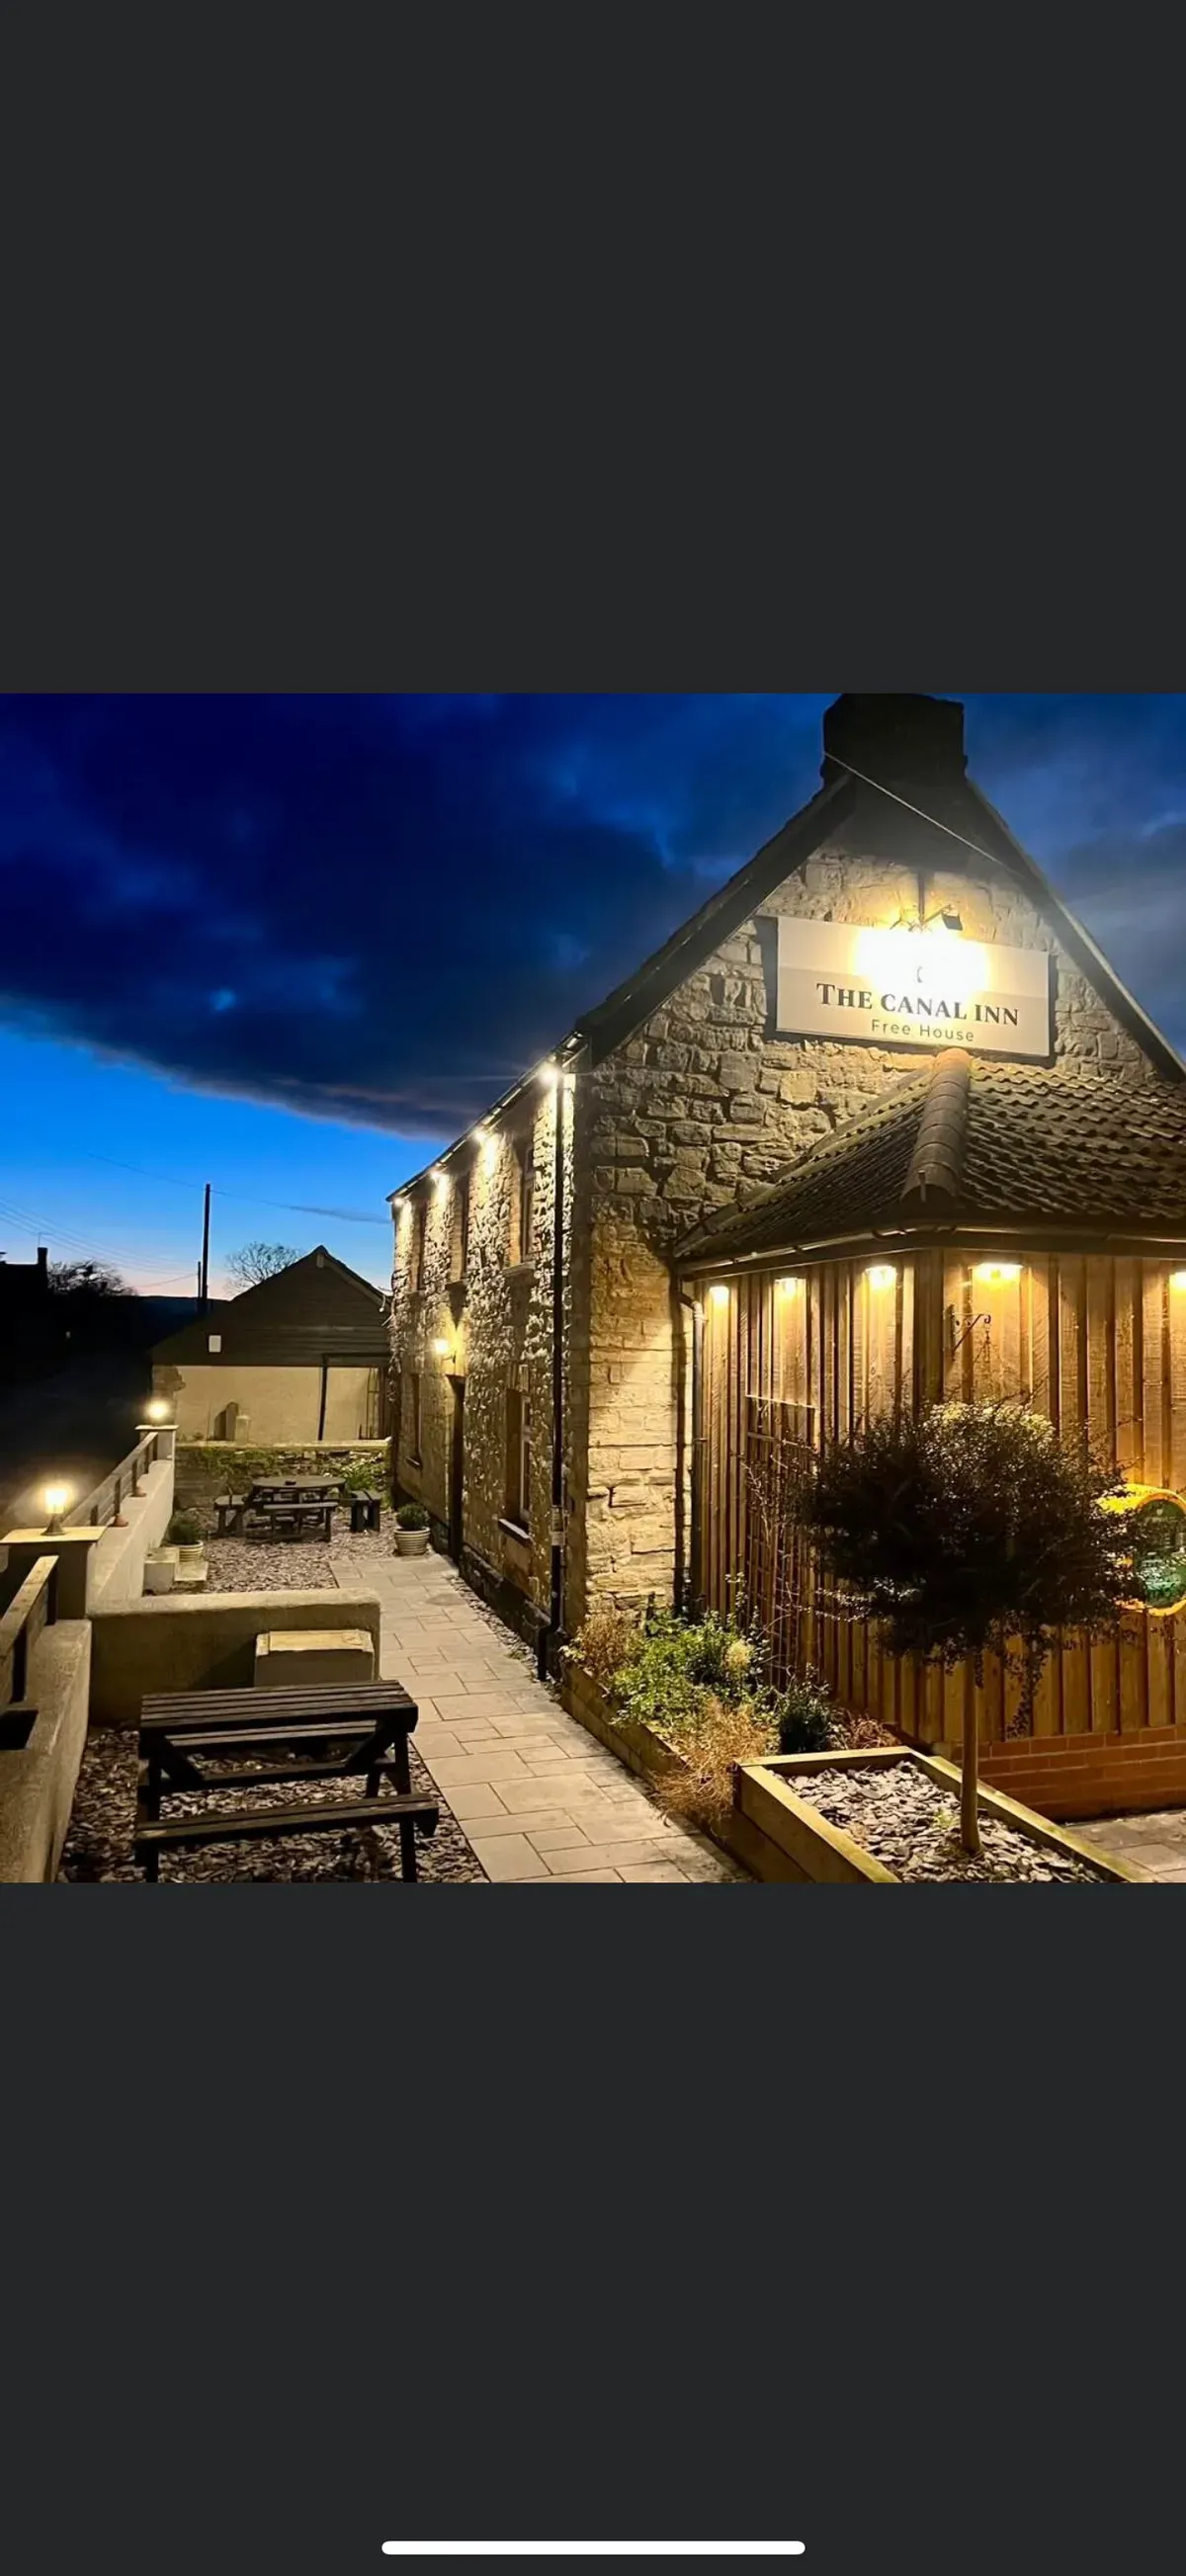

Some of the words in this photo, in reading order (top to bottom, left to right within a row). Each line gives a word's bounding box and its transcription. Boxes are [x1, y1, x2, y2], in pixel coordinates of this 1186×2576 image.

[816, 983, 873, 1010] THE
[881, 993, 968, 1021] CANAL
[974, 1004, 1019, 1027] INN
[872, 1019, 910, 1036] Free
[919, 1024, 974, 1042] House
